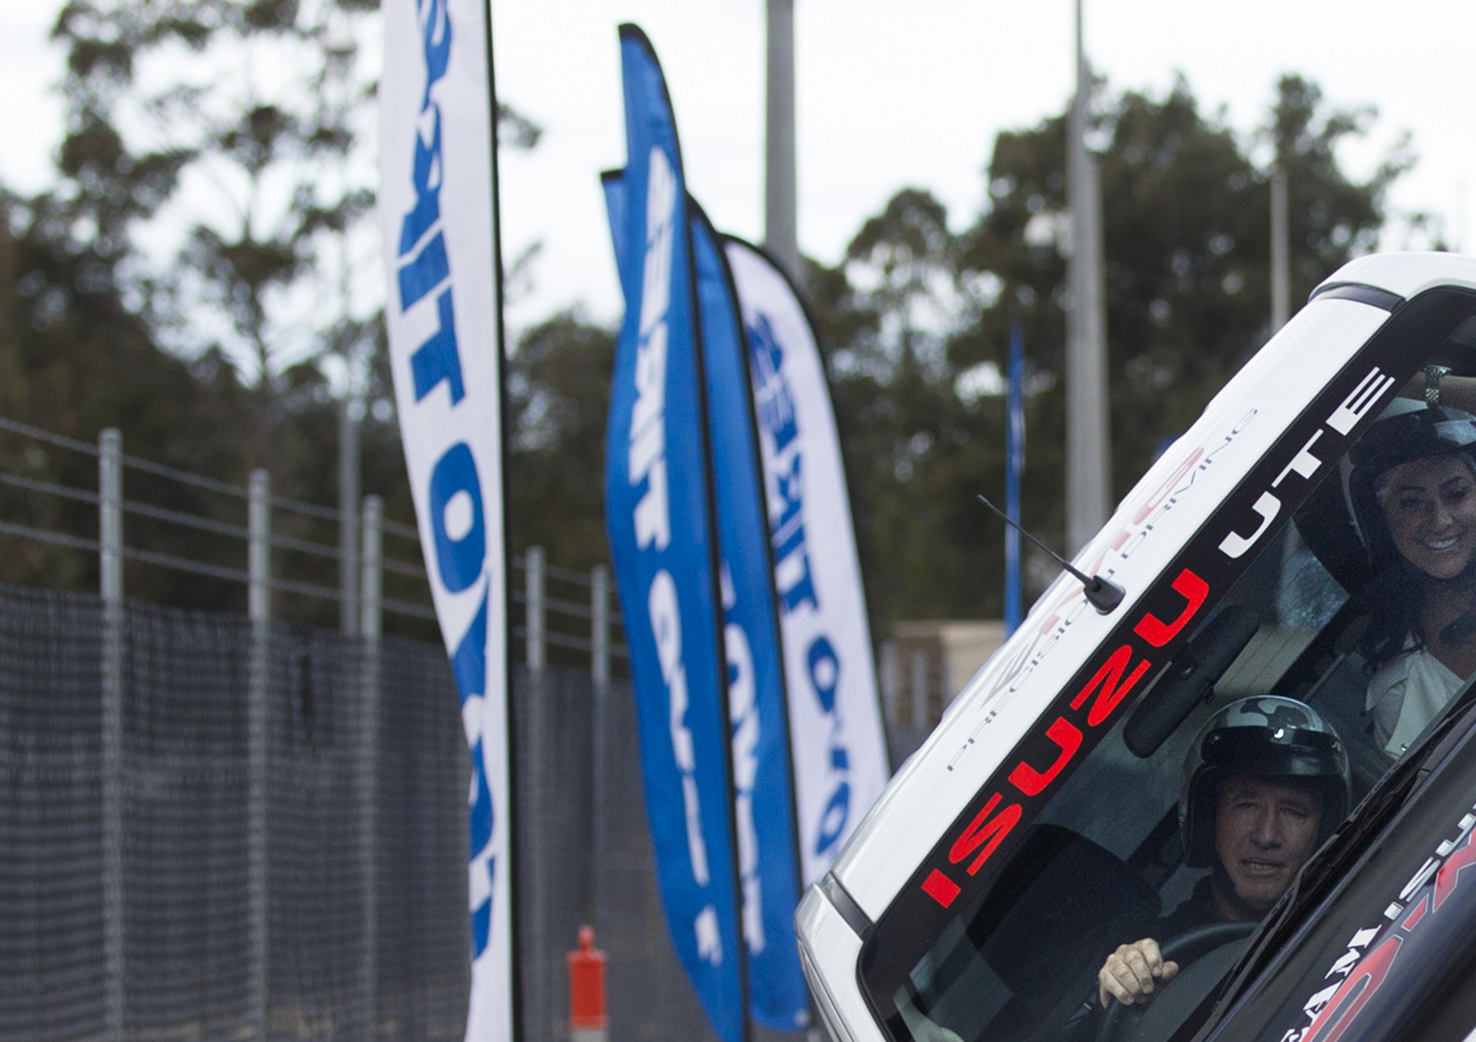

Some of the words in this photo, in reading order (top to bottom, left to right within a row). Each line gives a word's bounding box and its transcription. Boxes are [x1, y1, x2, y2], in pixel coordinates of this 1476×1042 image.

[921, 567, 1210, 909] ISUZU
[1218, 366, 1396, 559] UTE
[1121, 408, 1259, 560] DRIVING
